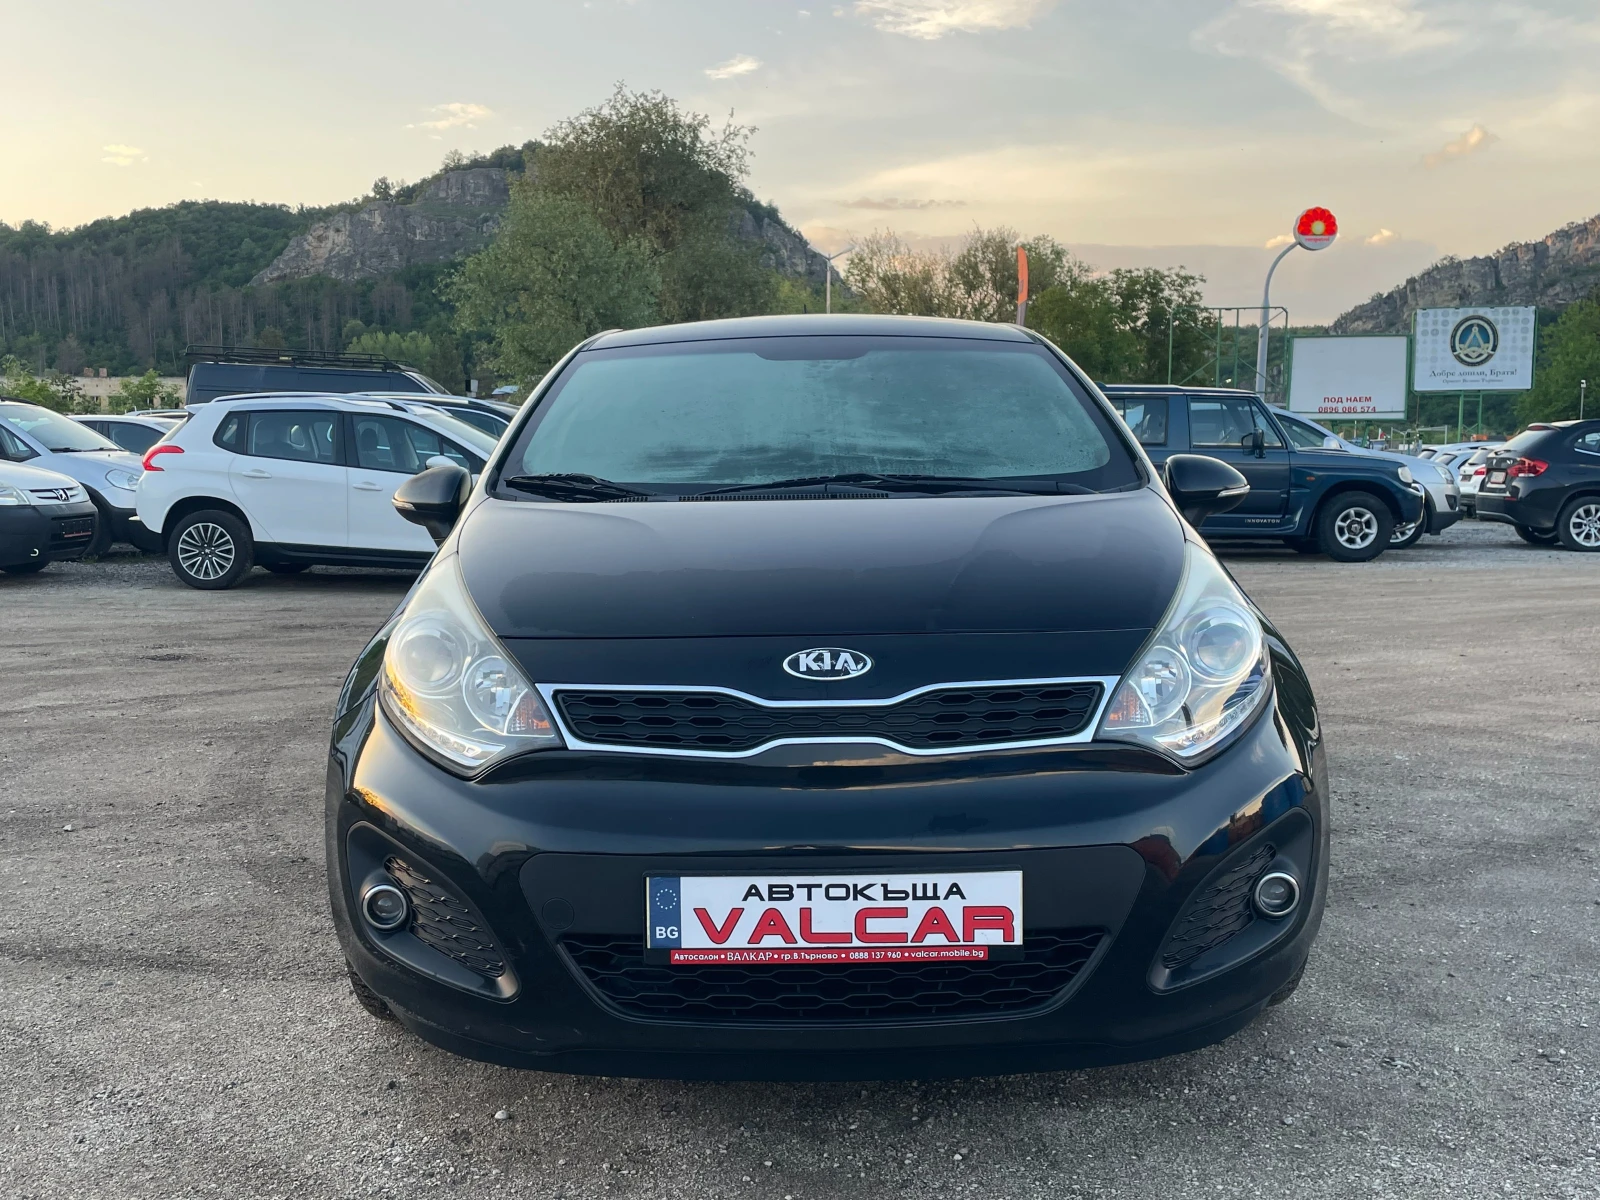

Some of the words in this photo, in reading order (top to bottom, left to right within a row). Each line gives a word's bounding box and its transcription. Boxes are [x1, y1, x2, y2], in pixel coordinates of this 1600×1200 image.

[1490, 368, 1518, 377] Братя!
[1323, 396, 1343, 404] ПОД
[799, 651, 858, 672] KIA
[693, 906, 1015, 944] VALCAR
[655, 926, 679, 939] BG
[674, 953, 719, 961] Автосалон
[727, 952, 772, 961] ВАЛКАР
[850, 951, 869, 959] 0888
[872, 951, 885, 959] 137
[887, 951, 902, 959] 960
[911, 949, 984, 958] valcar.mobile.bg
